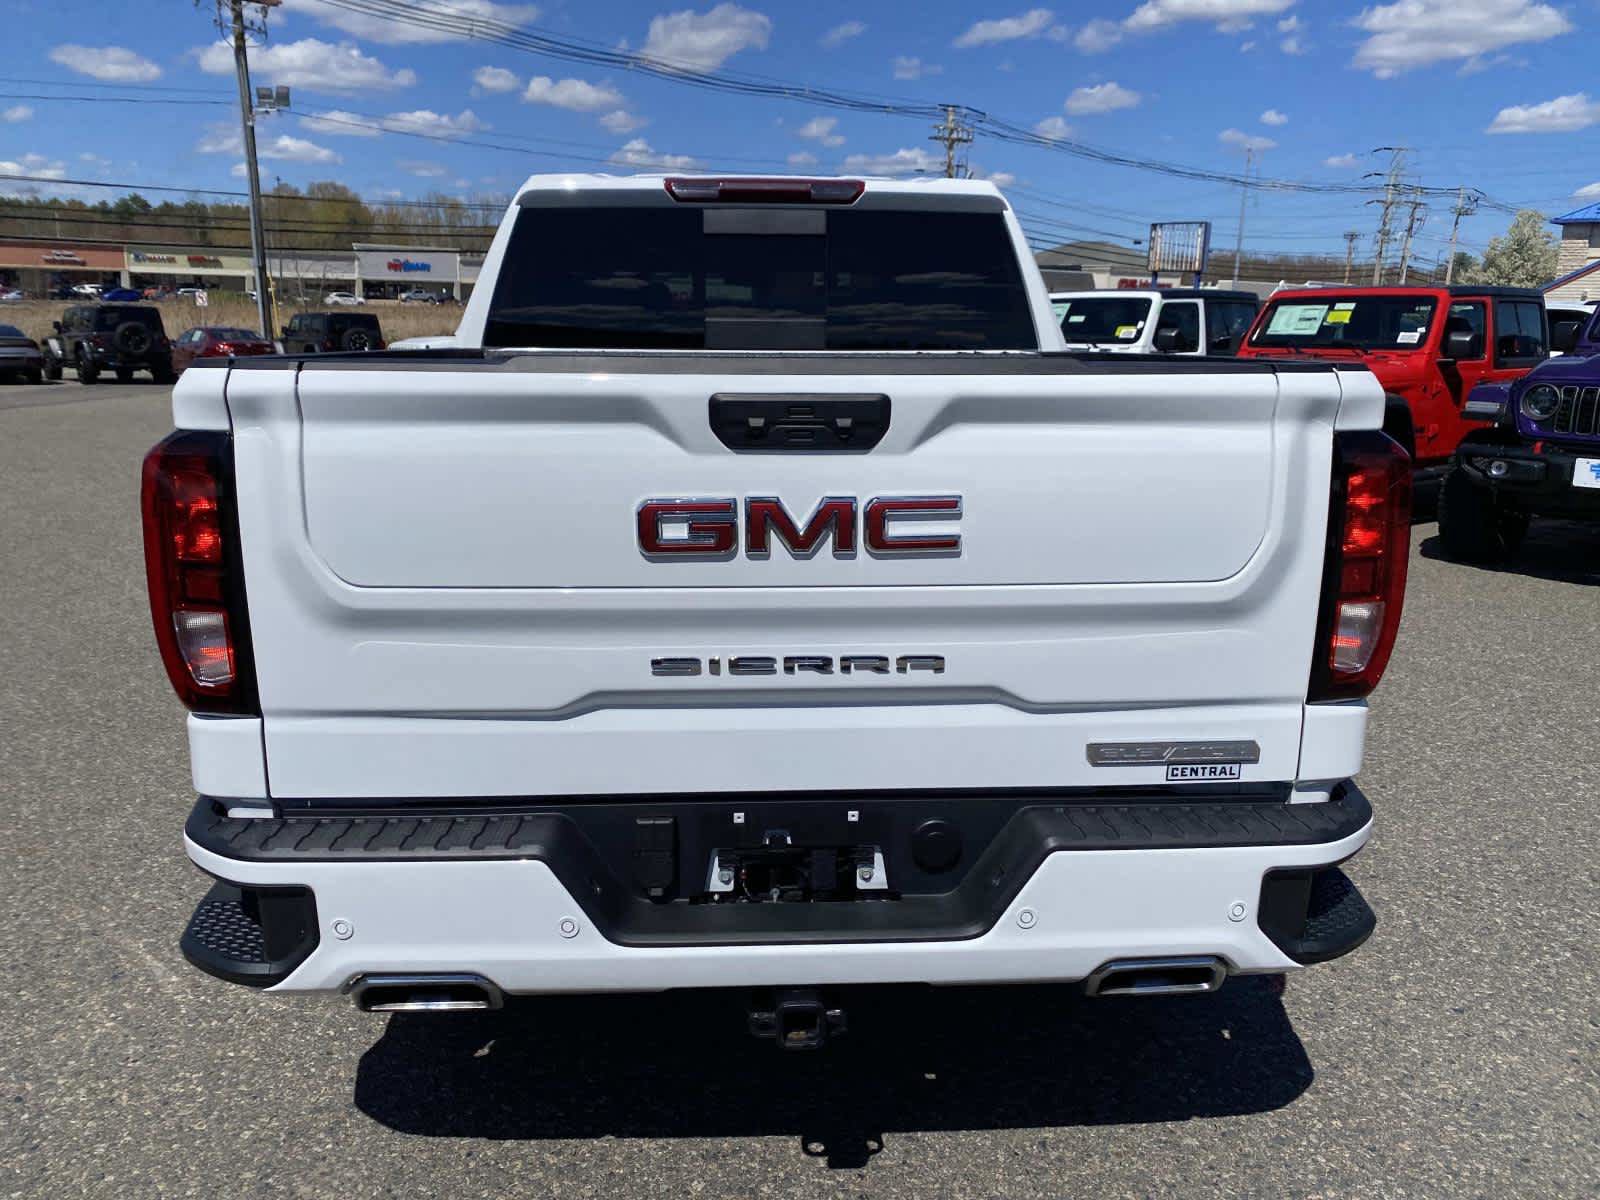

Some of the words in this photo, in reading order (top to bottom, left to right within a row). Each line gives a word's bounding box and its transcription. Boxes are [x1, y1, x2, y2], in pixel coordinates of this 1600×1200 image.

[637, 495, 963, 562] GMC
[650, 656, 946, 676] SIERRA
[1170, 766, 1237, 778] CENTRAL
